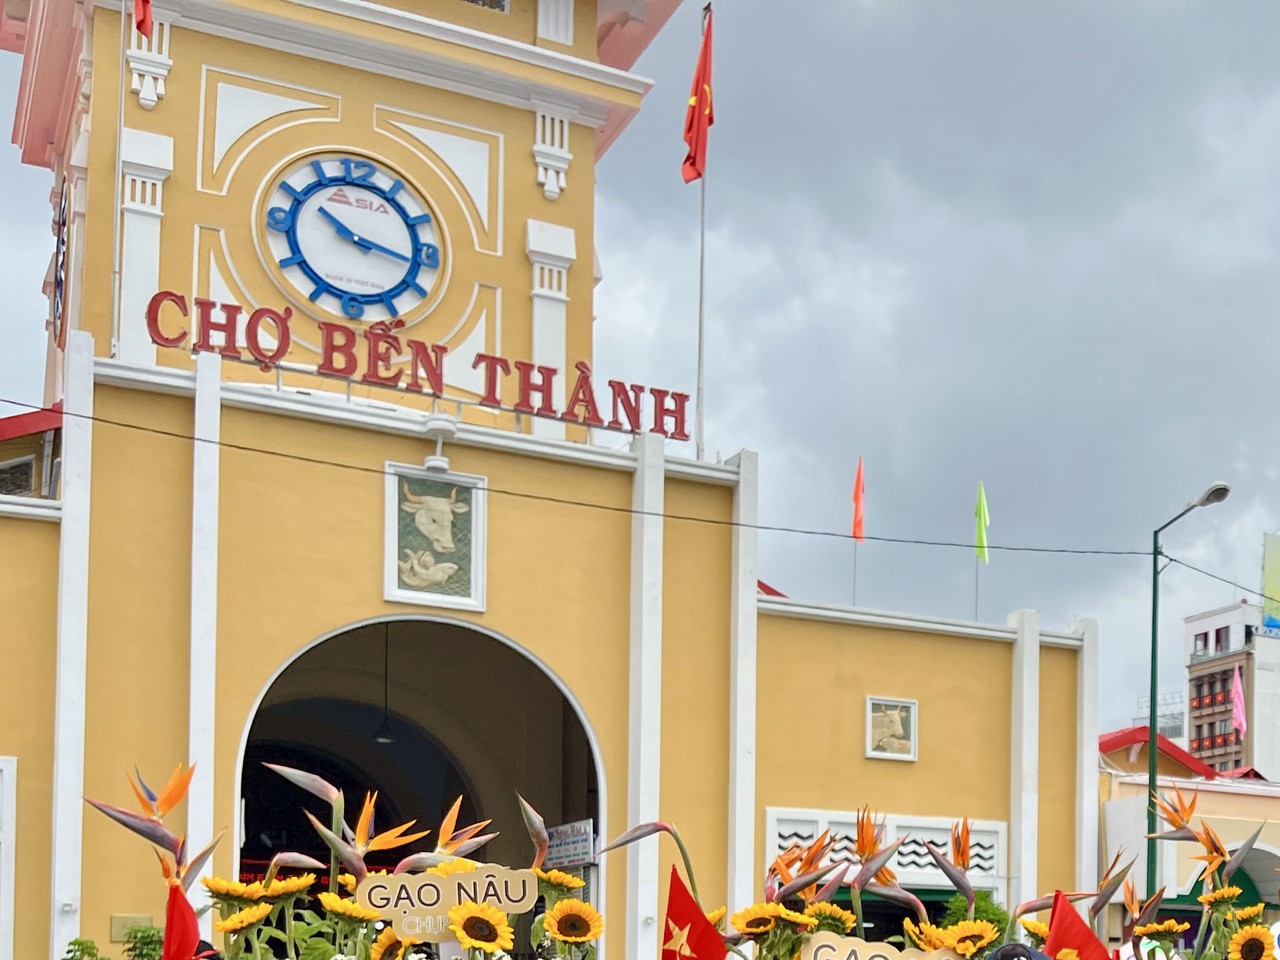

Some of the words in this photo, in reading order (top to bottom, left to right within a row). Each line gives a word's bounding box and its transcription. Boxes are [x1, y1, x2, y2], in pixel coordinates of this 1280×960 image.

[340, 158, 377, 187] 12
[145, 290, 293, 373] CHỢ
[318, 318, 448, 399] BẾN
[472, 360, 691, 441] THÀNH
[367, 882, 441, 915] GẠO
[456, 874, 528, 906] NÂU
